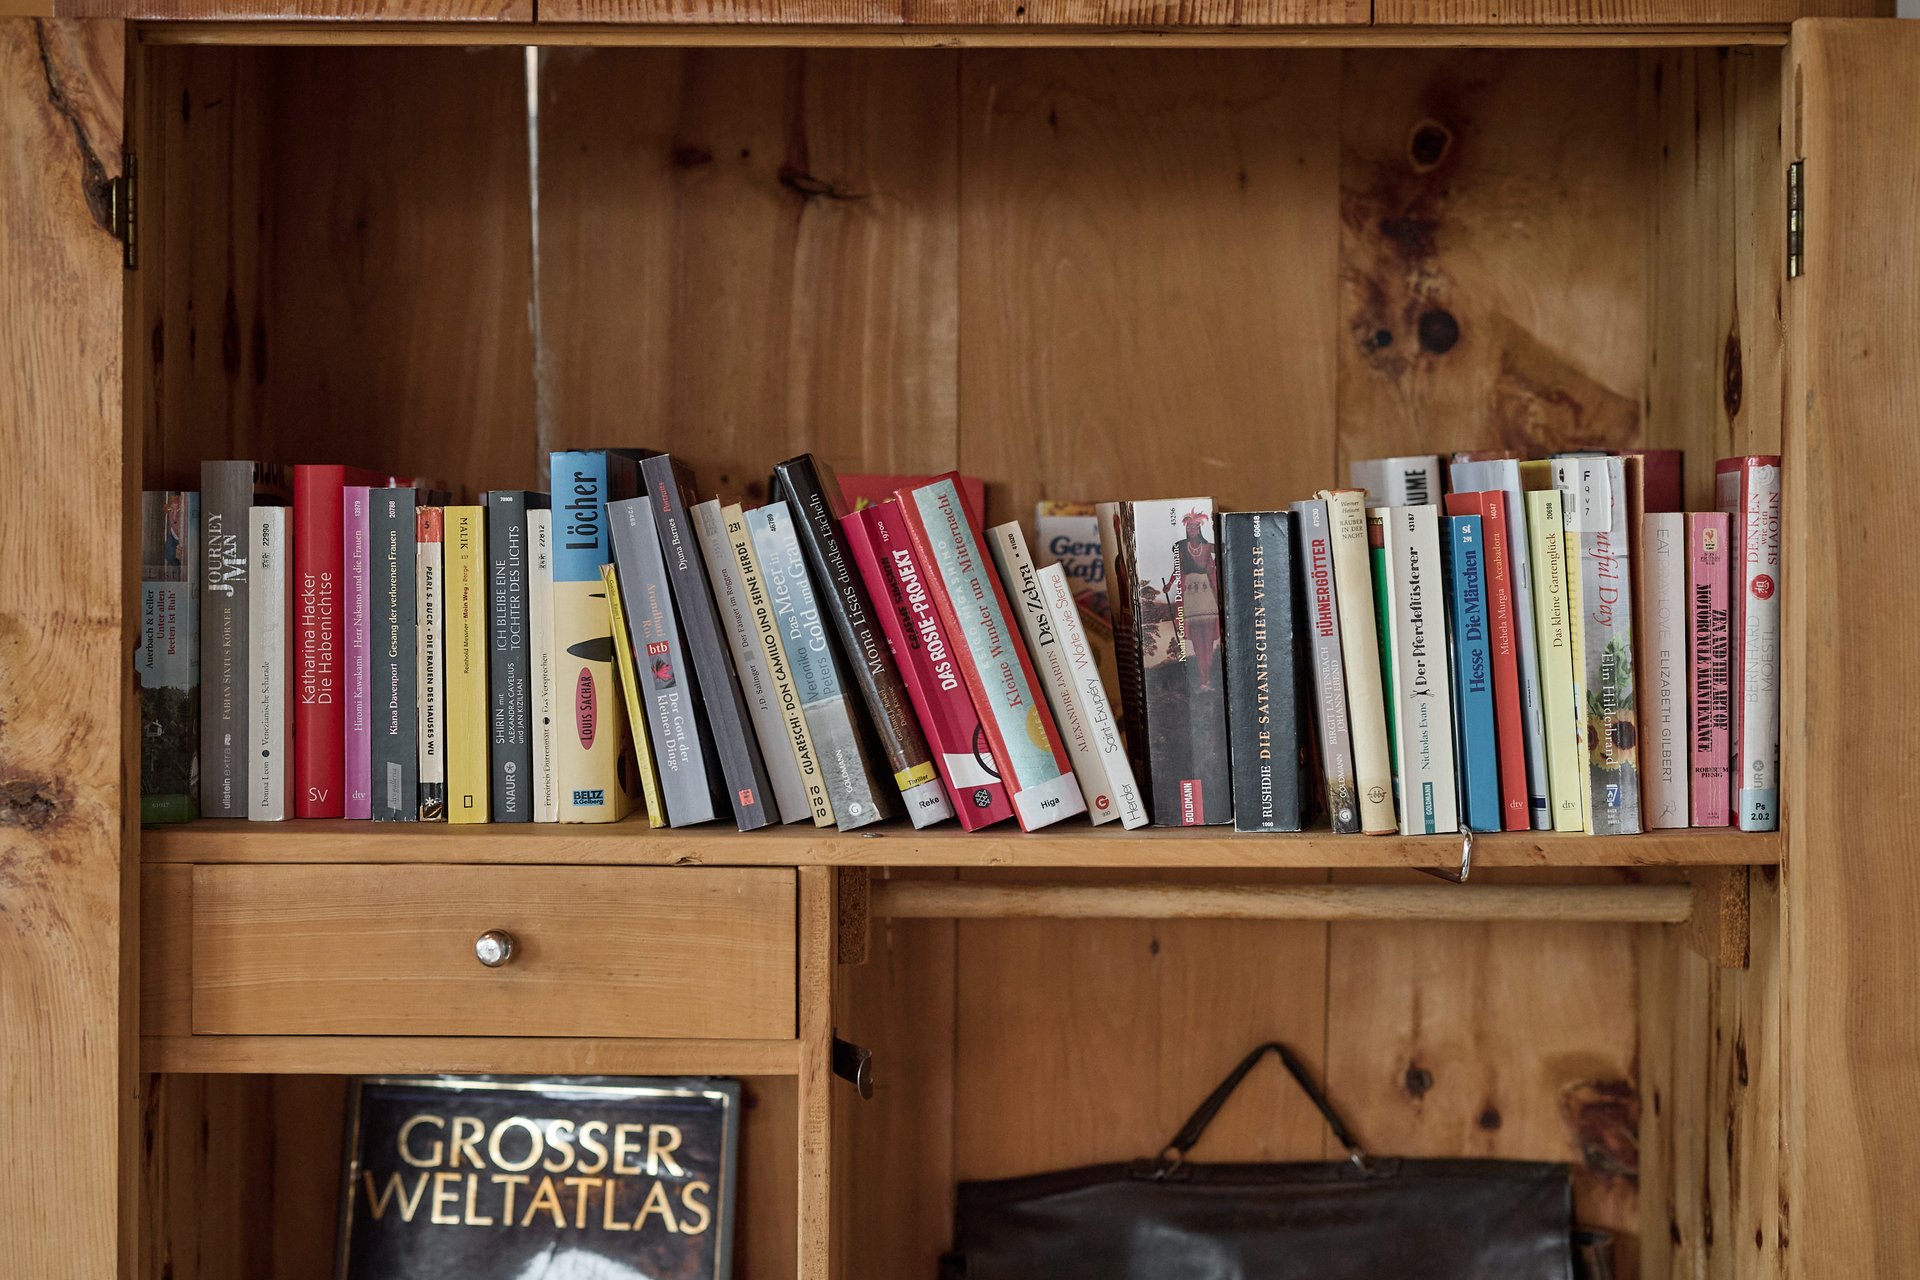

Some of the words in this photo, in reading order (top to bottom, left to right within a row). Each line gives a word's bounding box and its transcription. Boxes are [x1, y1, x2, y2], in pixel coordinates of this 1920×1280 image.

[563, 470, 598, 549] Löcher
[809, 493, 832, 537] Lächeln
[1407, 512, 1415, 531] 43187
[1759, 510, 1768, 525] ein
[728, 521, 741, 533] 231
[938, 494, 973, 572] Mitternacht
[1462, 524, 1472, 534] st
[1745, 492, 1761, 562] DENKEN
[1758, 528, 1767, 544] wie
[1765, 491, 1780, 565] SHAOLIN
[207, 511, 233, 597] JOURNEY
[222, 534, 247, 582] MAN
[388, 530, 397, 559] Frauen
[508, 524, 519, 566] LICHTS
[735, 541, 753, 574] HERDE
[768, 551, 780, 565] in
[828, 539, 849, 583] dunkles
[1491, 532, 1504, 581] Accabadora
[495, 559, 506, 585] EINE
[1171, 542, 1182, 584] Schamane
[1252, 545, 1265, 600] VERSE
[1545, 531, 1560, 593] Gartenglück
[389, 562, 397, 606] verlorenen
[509, 569, 520, 591] DES
[721, 568, 733, 595] Roggen
[746, 577, 763, 605] SEINE
[771, 568, 794, 616] Meer
[968, 577, 983, 601] um
[1019, 564, 1043, 612] Zebra
[1051, 574, 1068, 609] Sterne
[1174, 586, 1182, 602] Der
[1311, 539, 1332, 636] HÜHNERGÖTTER
[1460, 549, 1480, 614] Märchen
[145, 589, 153, 615] Keller
[156, 589, 164, 612] allen
[301, 572, 315, 625] Hacker
[496, 589, 506, 626] BLEIBE
[647, 584, 665, 636] Arundhati
[728, 595, 737, 606] im
[843, 586, 865, 626] Lisas
[893, 550, 945, 660] ROSIE-PROJEKT
[1407, 545, 1426, 656] Pferdeflüsterer
[1496, 588, 1508, 619] Murgia
[1549, 595, 1561, 625] kleine
[146, 617, 153, 625] &
[156, 613, 164, 639] Unter
[318, 572, 332, 672] Habenichtse
[389, 609, 397, 623] der
[509, 595, 521, 650] TOCHTER
[640, 619, 651, 638] Roy
[733, 608, 744, 633] Fänger
[755, 607, 771, 632] UND
[788, 615, 801, 639] Das
[979, 606, 1003, 657] Wunder
[1036, 613, 1054, 646] Das
[1062, 610, 1075, 631] wie
[1175, 605, 1185, 637] Gordon
[1464, 614, 1482, 641] Die
[1695, 583, 1712, 665] MOTORCYCLE
[1711, 609, 1727, 632] ZEN
[145, 626, 153, 669] Auerbach
[389, 626, 398, 657] Gesang
[496, 630, 506, 650] ICH
[649, 641, 668, 655] btb
[739, 633, 749, 647] Der
[860, 629, 884, 675] Mona
[1071, 633, 1088, 669] Worte
[1177, 639, 1186, 662] Noah
[1498, 620, 1509, 655] Michela
[1551, 627, 1562, 647] Das
[1711, 635, 1727, 658] AND
[301, 630, 315, 704] Katharina
[763, 633, 786, 681] CAMILLO
[1046, 650, 1065, 687] JARDIN
[1254, 606, 1269, 723] SATANISCHEN
[1413, 659, 1427, 685] Der
[1467, 648, 1485, 692] Hesse
[1600, 652, 1614, 680] Elin
[1711, 659, 1728, 686] THE
[1744, 615, 1763, 703] BERNHARD
[1758, 625, 1776, 691] MOESTL
[389, 663, 399, 708] Davenport
[750, 665, 763, 694] Salinger
[817, 657, 834, 695] Peters
[934, 660, 957, 691] DAS
[1000, 662, 1022, 708] Kleine
[1320, 647, 1335, 711] LAUTENBACH
[1329, 658, 1341, 690] EBEND
[318, 678, 332, 704] Die
[578, 675, 591, 711] SACHAR
[758, 695, 768, 710] J.D.
[779, 683, 795, 710] DON
[1711, 690, 1728, 713] ART
[389, 710, 398, 734] Kiana
[495, 708, 504, 743] SHIRIN
[657, 694, 670, 736] kleinen
[1061, 690, 1088, 751] ALEXANDRE
[1334, 693, 1347, 732] JOHANN
[1417, 702, 1428, 727] Evans
[1602, 685, 1618, 764] Hilderbrand
[1695, 667, 1713, 752] MAINTENANCE
[1712, 713, 1728, 730] OF
[579, 713, 593, 741] LOUIS
[668, 692, 678, 712] Der
[674, 716, 684, 740] Gott
[679, 744, 689, 762] der
[1327, 714, 1337, 744] BIRGIT
[663, 738, 681, 772] Dinge
[790, 717, 813, 774] GUARESCHI
[1259, 730, 1270, 759] DIE
[1419, 730, 1430, 769] Nicholas
[834, 749, 853, 793] GOLDMANN
[907, 774, 929, 786] Thriller
[1337, 754, 1347, 798] GOLDMANN
[222, 777, 230, 808] ullstein
[309, 787, 328, 802] SV
[352, 791, 366, 799] dtv
[505, 773, 516, 812] KNAUR
[573, 790, 604, 800] BELTZ
[919, 796, 940, 809] Reke
[1040, 796, 1060, 810] Higa
[1120, 783, 1140, 821] Herder
[1183, 782, 1194, 822] GOLDMANN
[1260, 765, 1273, 817] RUSHDIE
[1510, 799, 1523, 808] dtv
[1562, 800, 1576, 809] dtv
[1755, 802, 1766, 810] Ps
[398, 1114, 685, 1178] GROSSER
[363, 1170, 712, 1236] WELTATLAS
